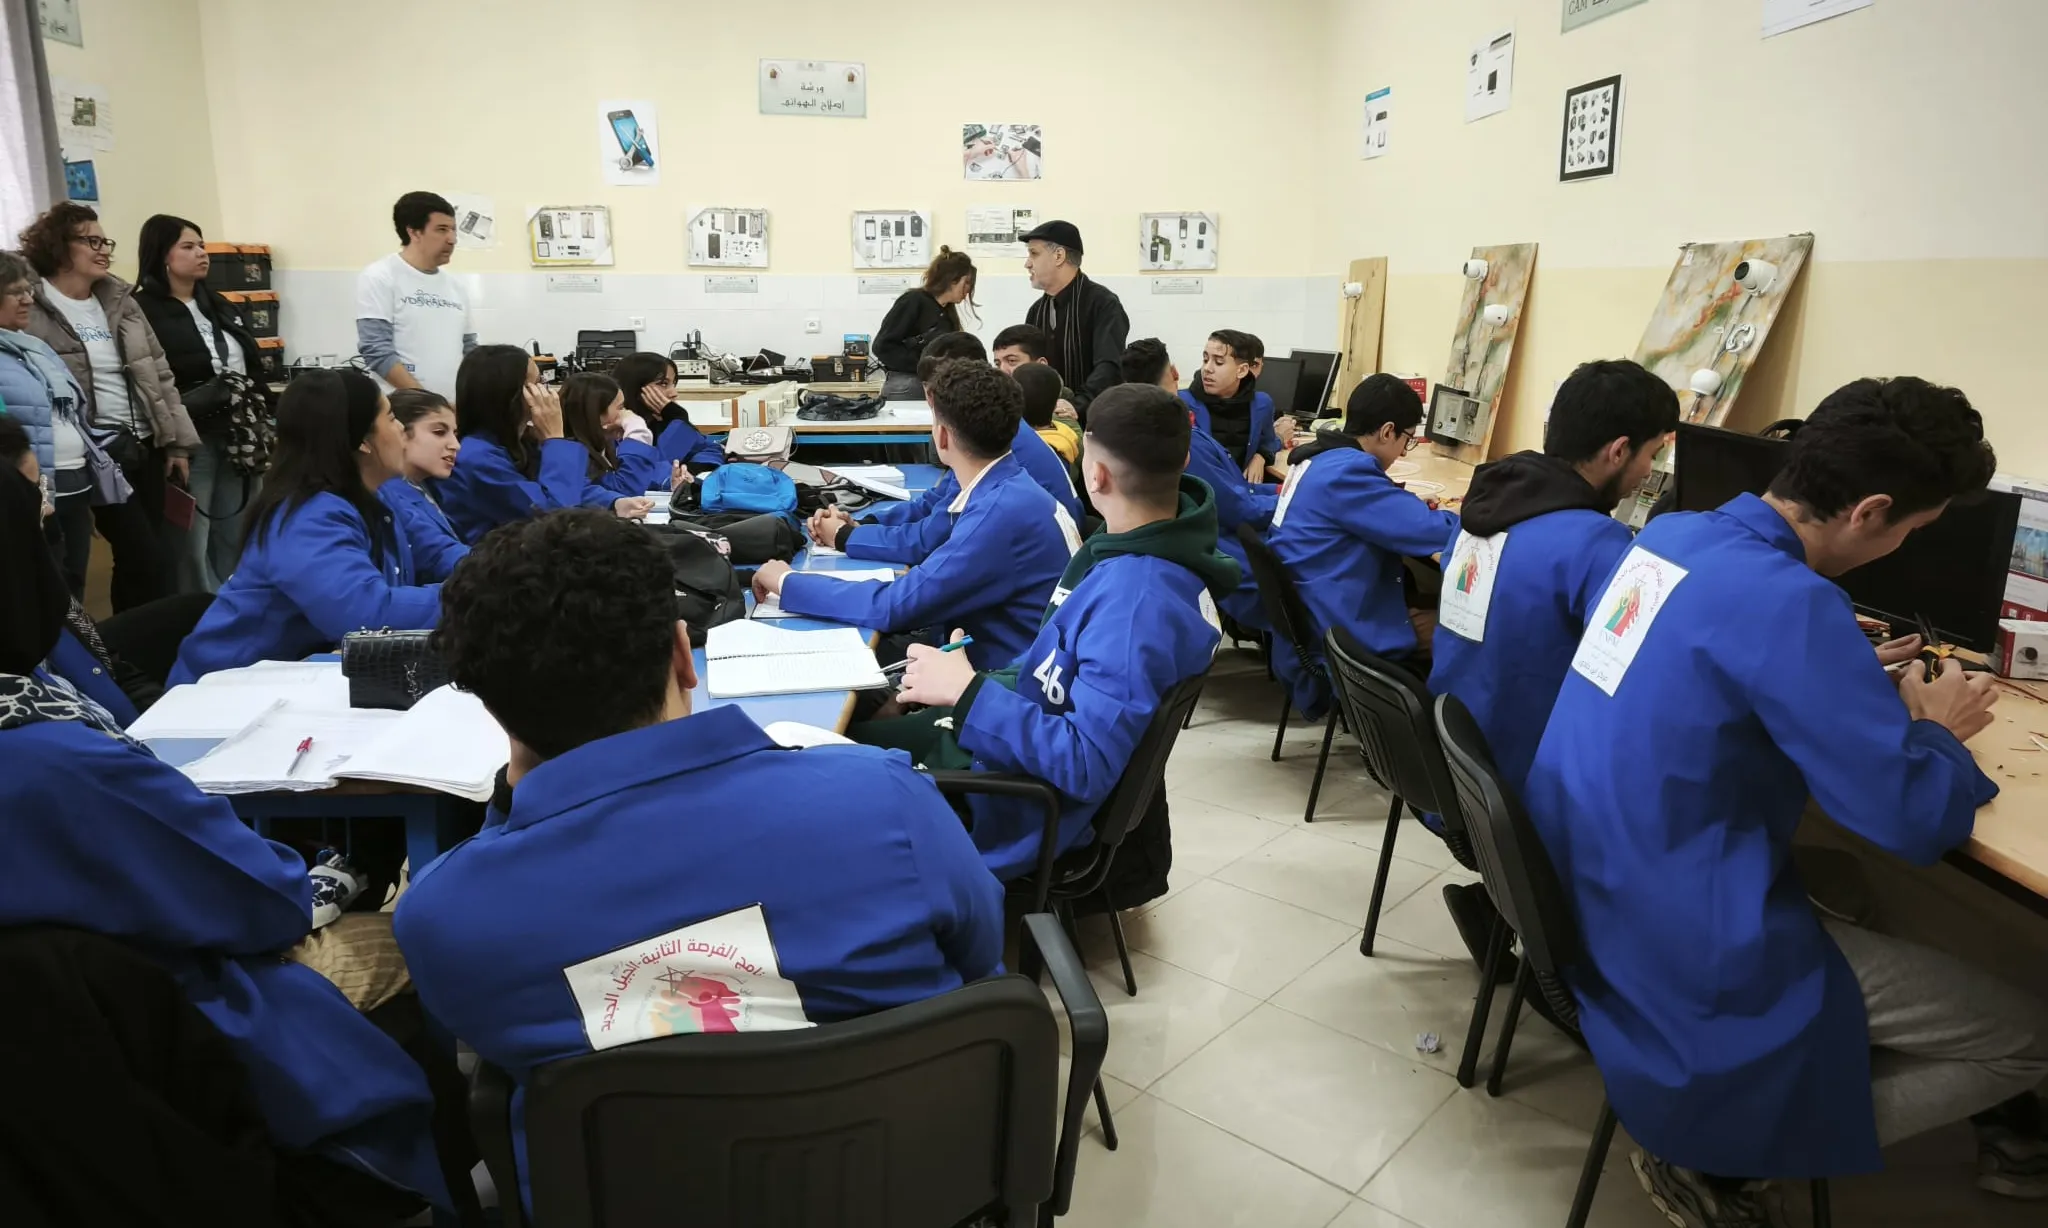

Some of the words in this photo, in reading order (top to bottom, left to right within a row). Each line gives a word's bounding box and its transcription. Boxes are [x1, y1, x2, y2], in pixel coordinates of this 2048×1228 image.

[800, 82, 824, 93] ورشة
[1032, 648, 1065, 705] 46
[687, 938, 738, 961] الفرصة
[735, 956, 767, 976] نامج
[601, 993, 620, 1032] الجديد
